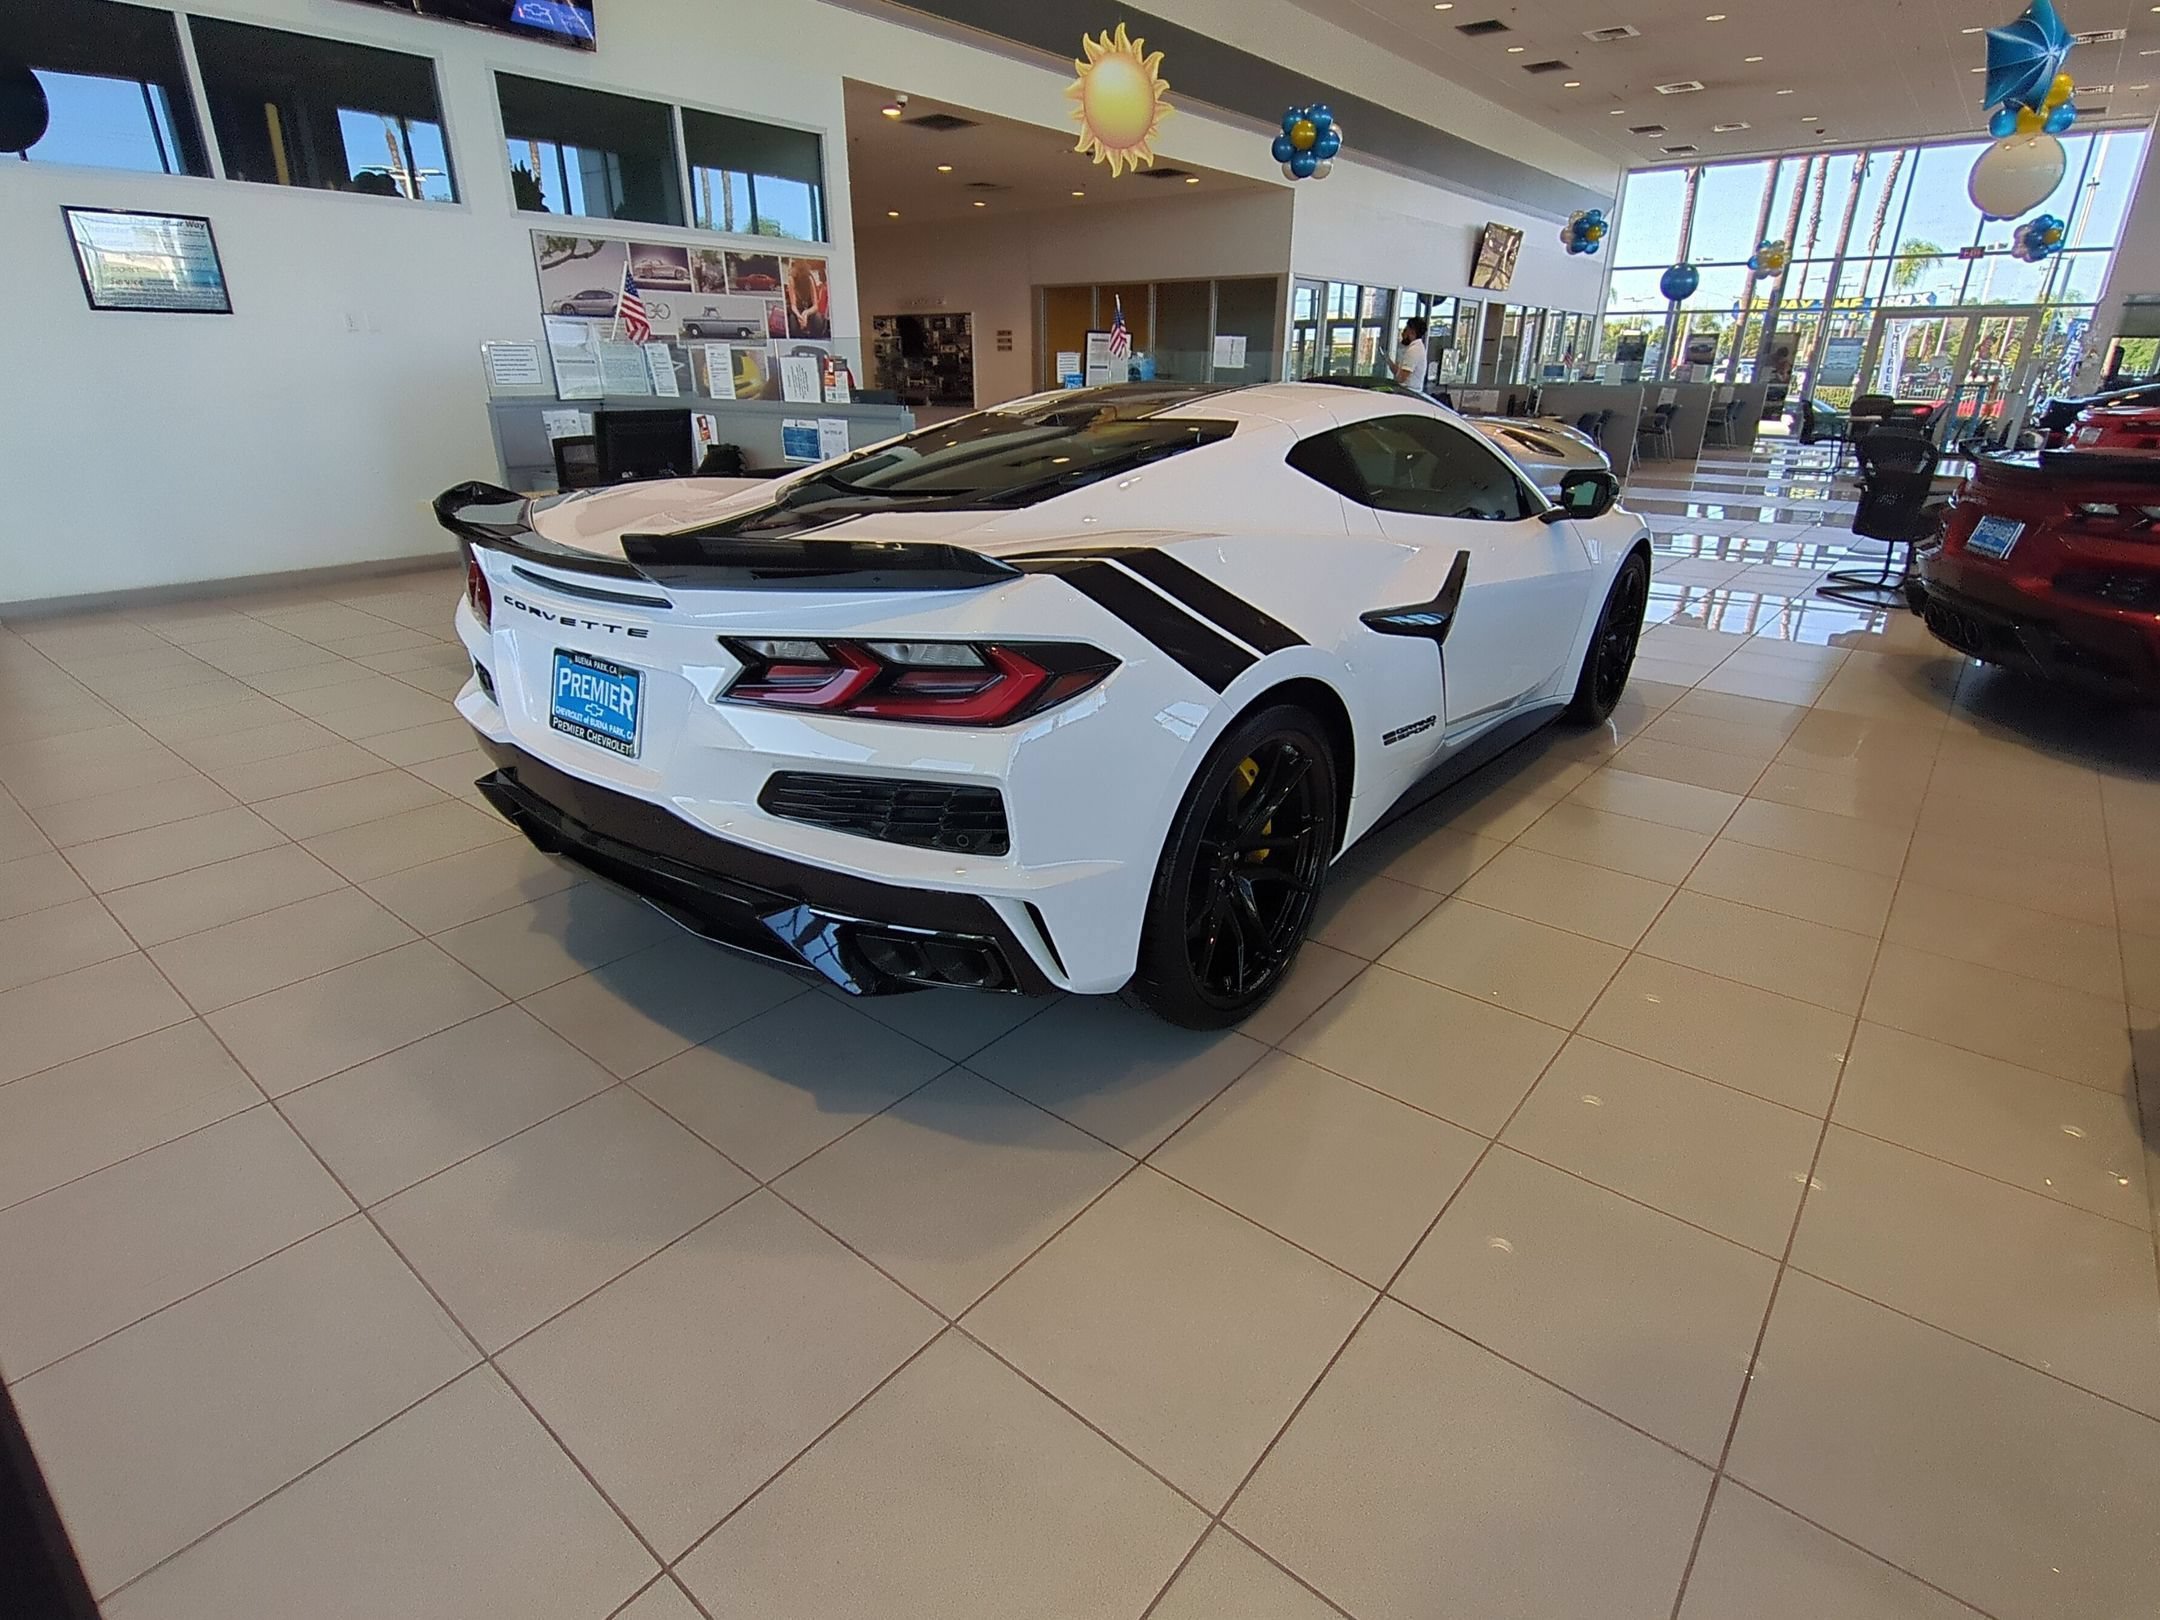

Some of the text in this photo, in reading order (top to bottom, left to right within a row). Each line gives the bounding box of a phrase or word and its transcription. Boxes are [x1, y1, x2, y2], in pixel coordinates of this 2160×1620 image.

[185, 220, 205, 230] Way
[503, 595, 650, 639] CORVETTE
[574, 655, 592, 668] BUENA
[558, 667, 635, 722] PREMIER
[555, 705, 583, 723] CHEVROLET
[590, 718, 608, 731] BUENA
[552, 717, 632, 755] PREMIER CHEVROLET
